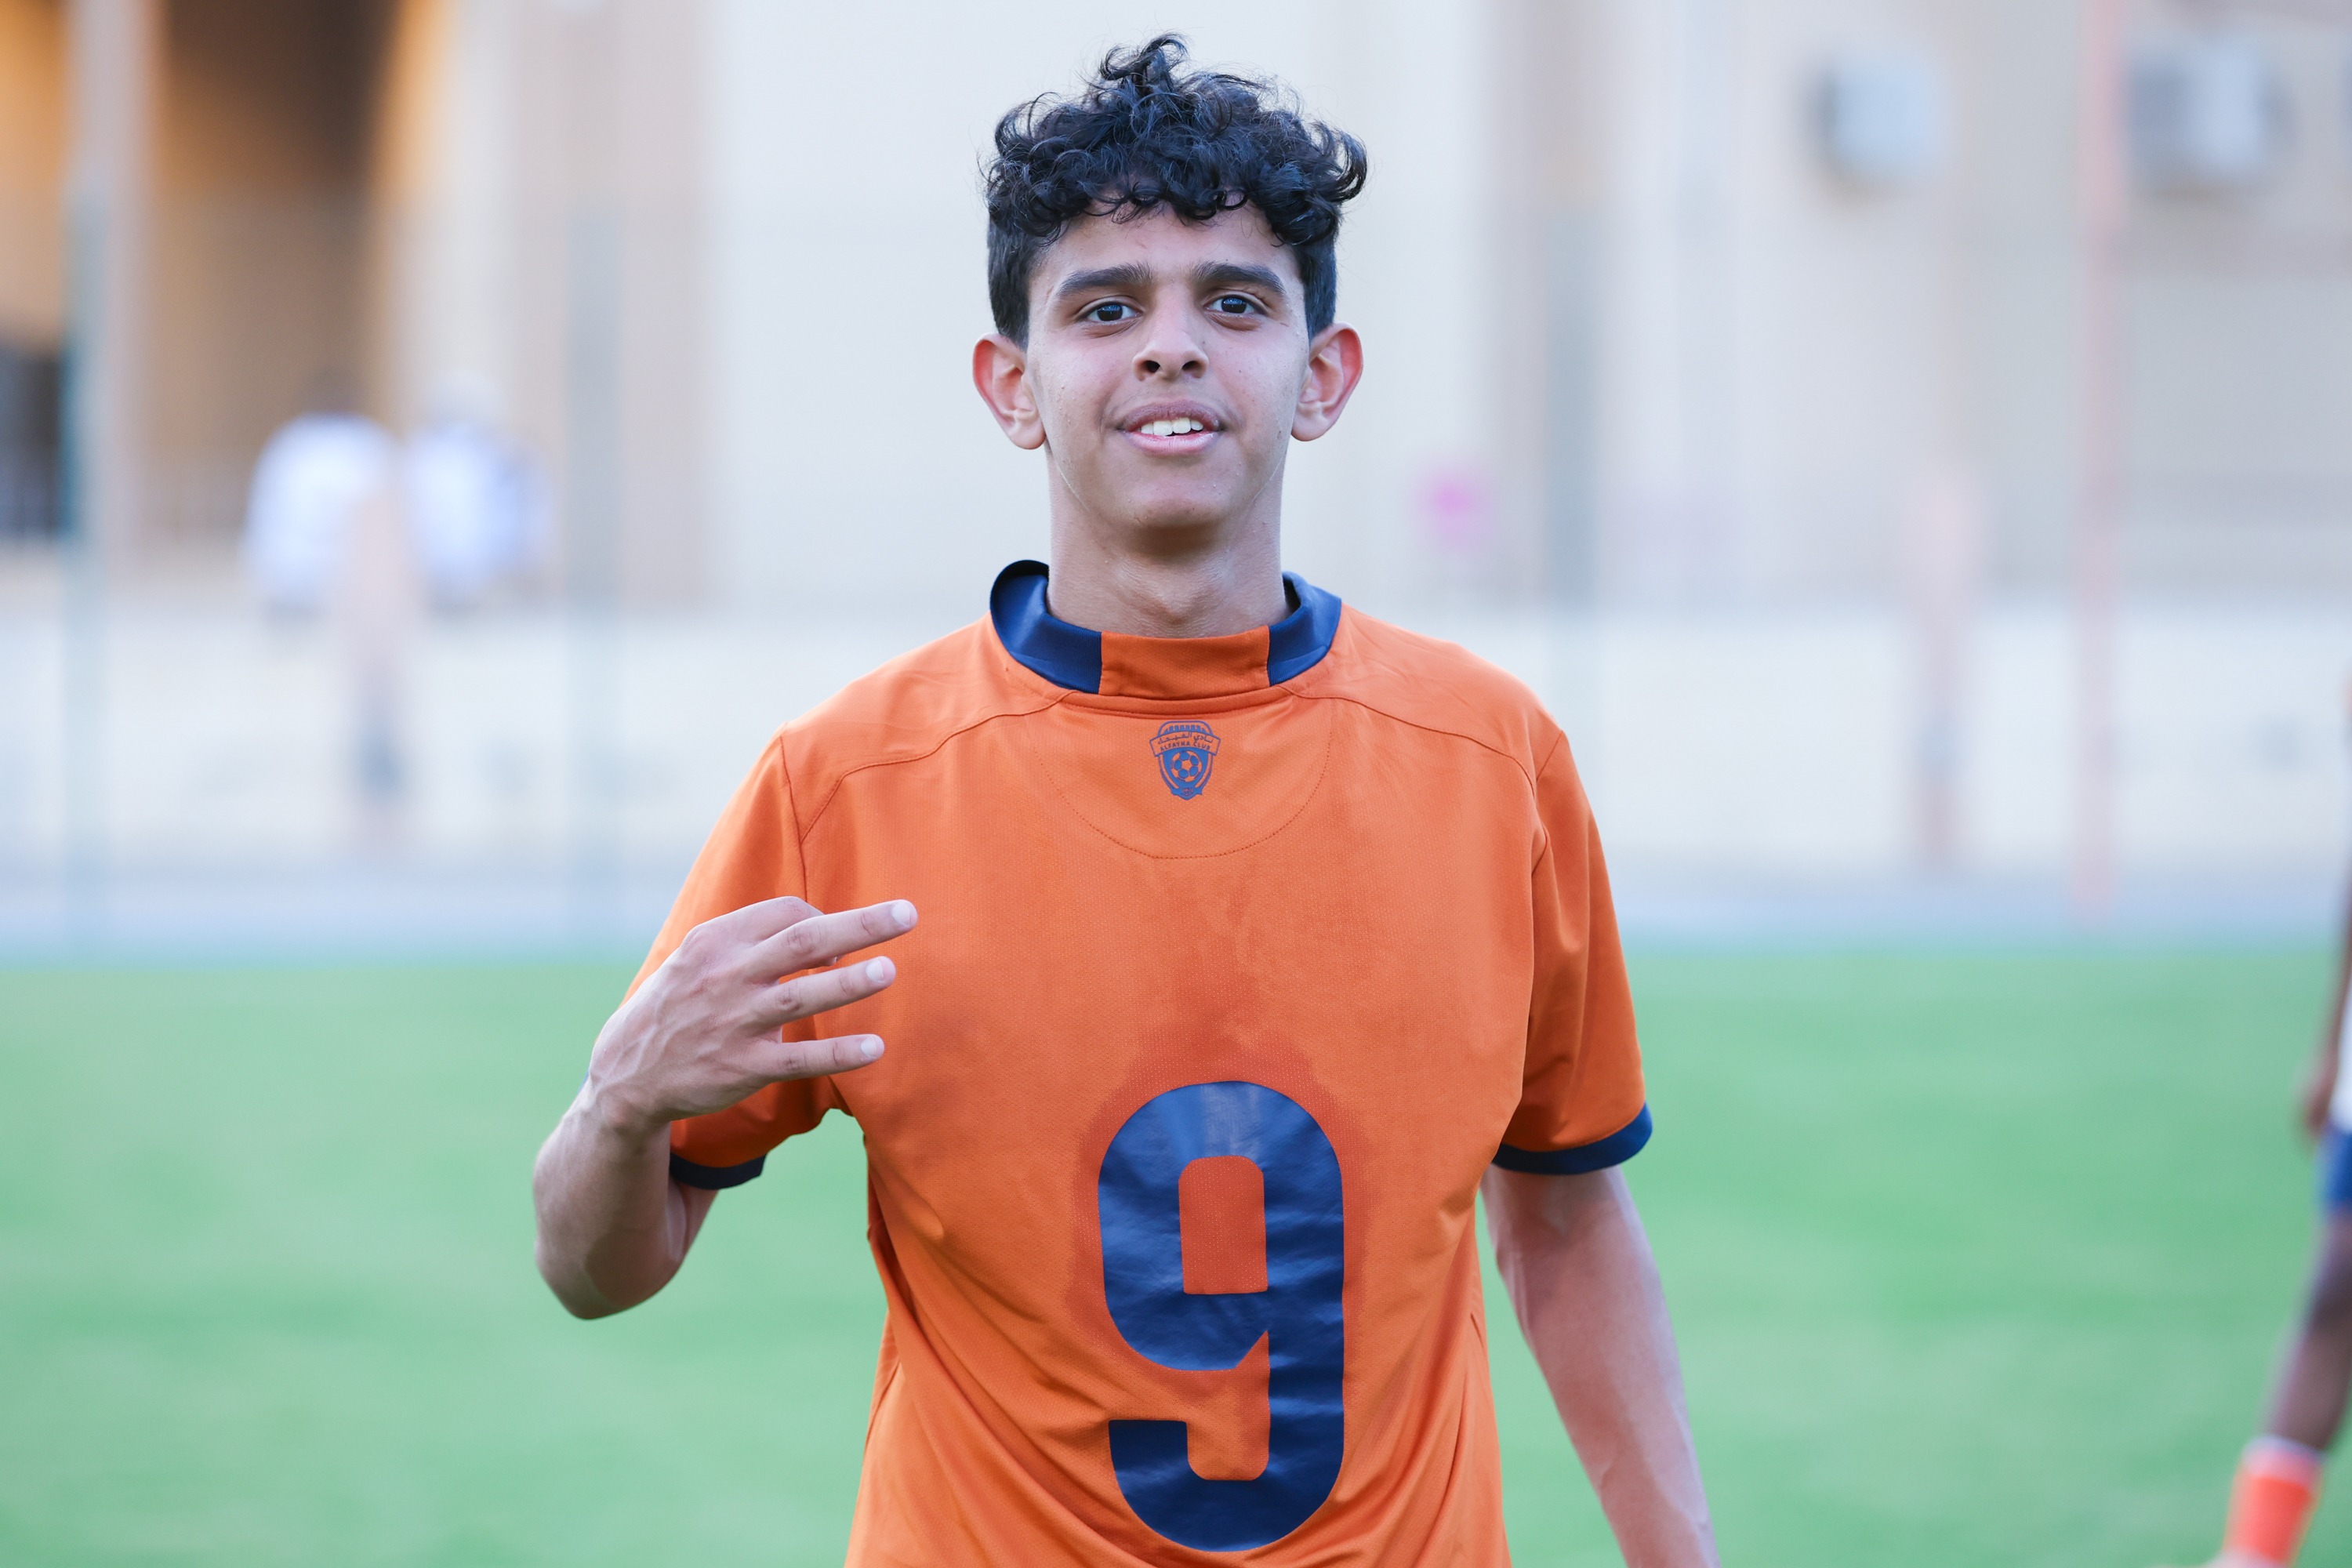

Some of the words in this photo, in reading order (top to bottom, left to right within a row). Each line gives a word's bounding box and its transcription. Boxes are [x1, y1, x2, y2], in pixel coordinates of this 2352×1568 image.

[1160, 741, 1190, 751] ALFAYHA
[1193, 742, 1210, 750] CLUB
[1098, 1081, 1345, 1552] 9
